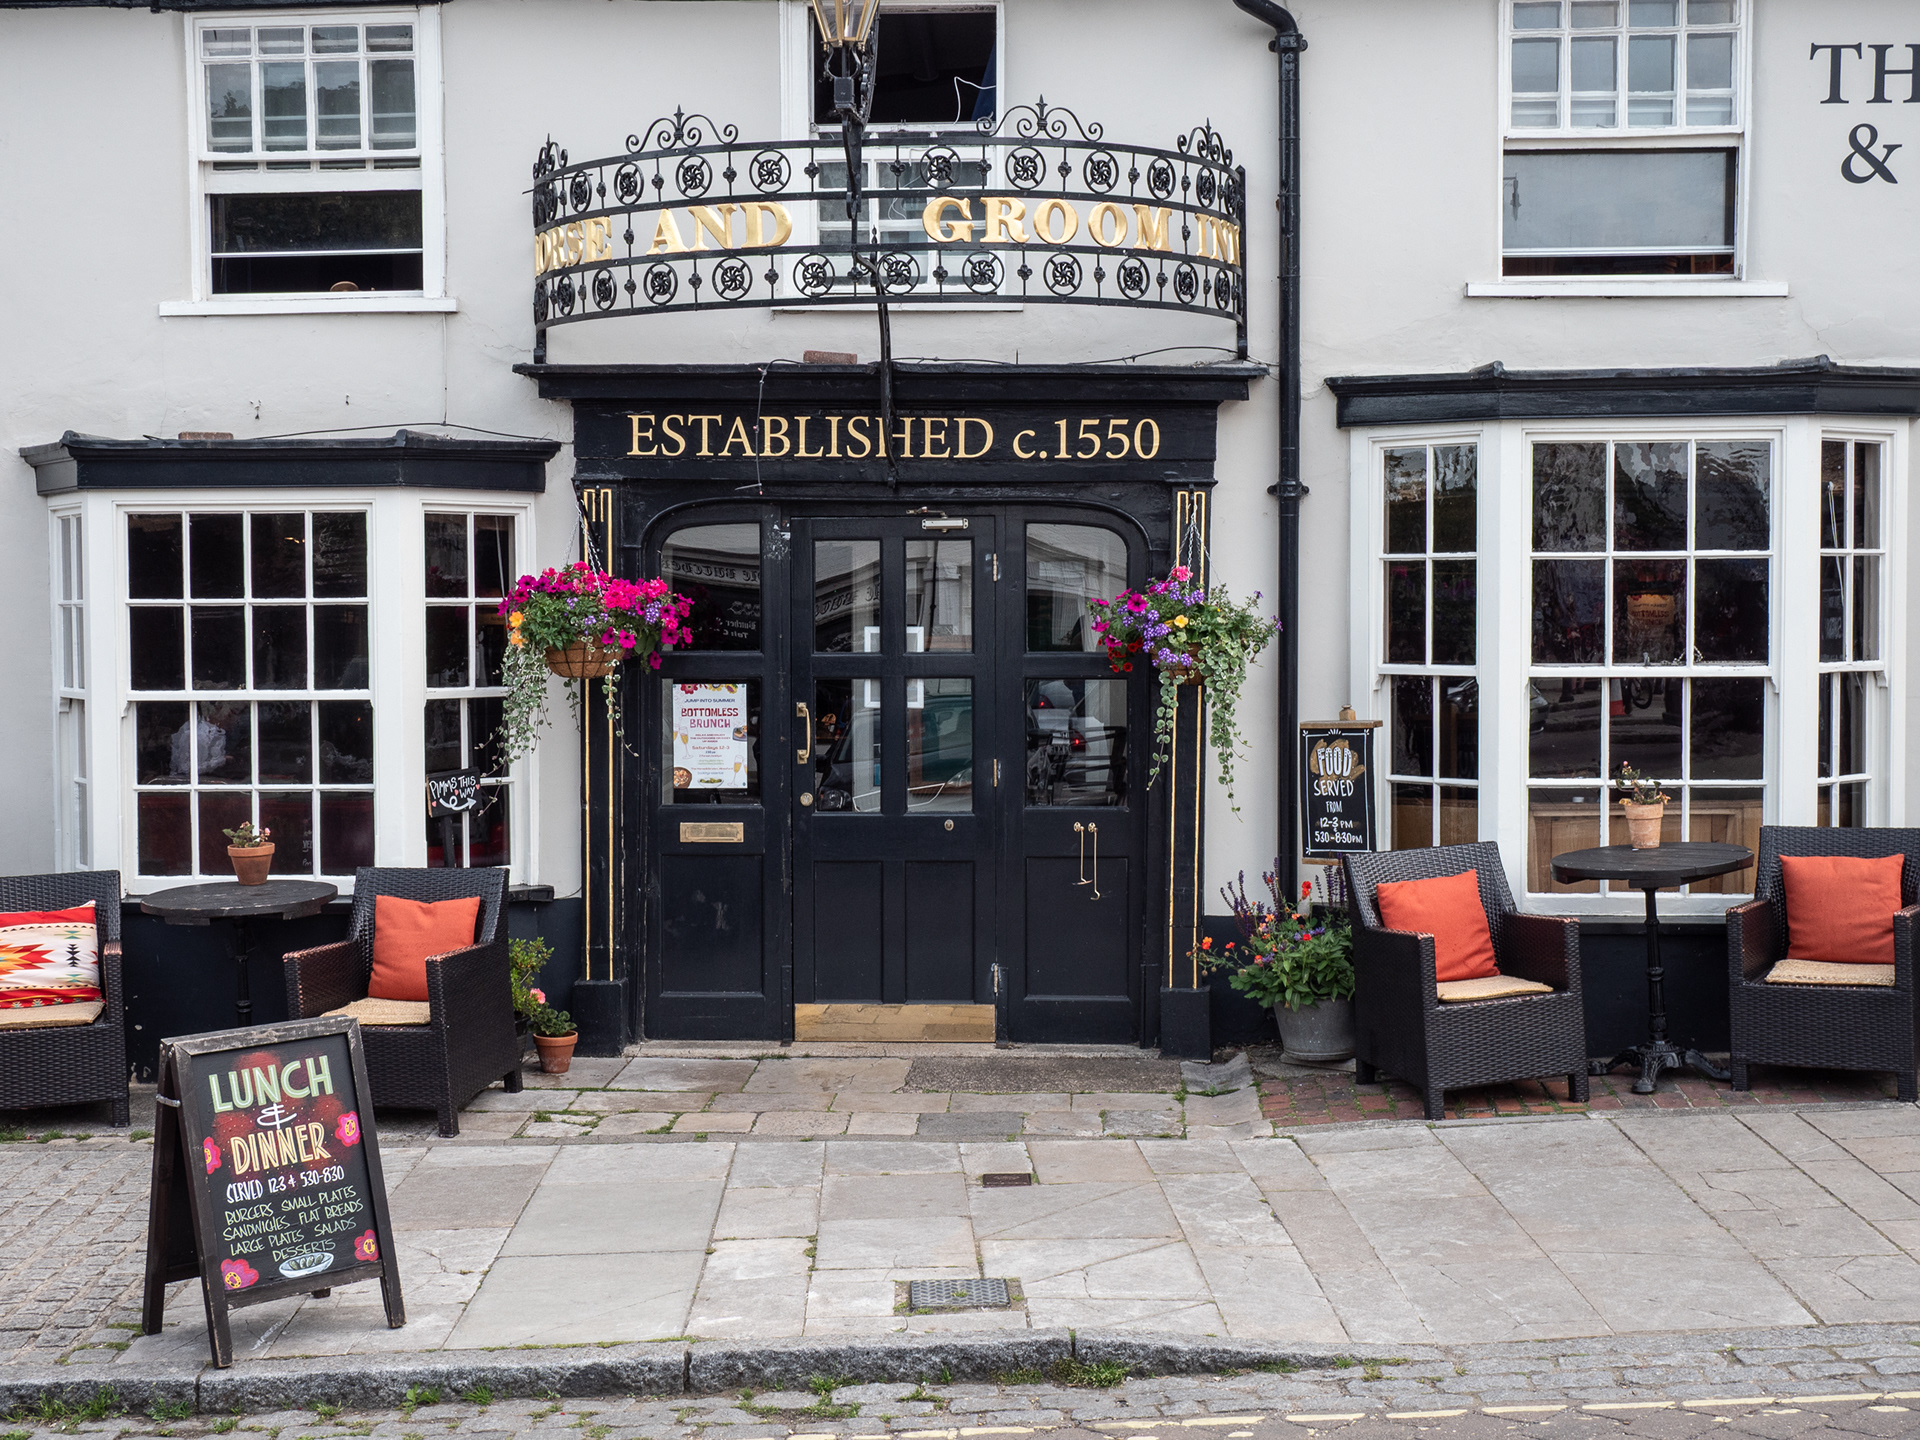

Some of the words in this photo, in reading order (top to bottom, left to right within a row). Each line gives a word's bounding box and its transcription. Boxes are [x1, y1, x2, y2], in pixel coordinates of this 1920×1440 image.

[1840, 123, 1903, 184] &
[535, 216, 612, 278] ORSE
[646, 201, 793, 255] AND
[922, 196, 1173, 252] GROOM
[626, 414, 994, 459] ESTABLISHED
[1012, 417, 1160, 460] c.1550
[681, 707, 739, 717] BOTTOMLESS
[690, 719, 731, 728] BRUNCH
[1316, 747, 1352, 777] FOOD
[458, 775, 476, 788] THIS
[459, 787, 476, 798] WAY
[1313, 779, 1354, 797] SERVED
[1325, 801, 1343, 814] FROM
[1320, 816, 1339, 828] 12-3
[1340, 820, 1353, 829] PM
[208, 1055, 334, 1114] LUNCH
[230, 1122, 332, 1175] DINNER
[226, 1178, 264, 1204] SERVED
[222, 1215, 291, 1241] SANDWICHES
[298, 1206, 321, 1226] FLAT
[324, 1198, 364, 1219] BREADS
[224, 1202, 275, 1226] BURGERS
[281, 1195, 318, 1212] SMALL
[318, 1185, 357, 1205] PLATES
[230, 1238, 266, 1257] LARGE
[268, 1229, 305, 1248] PLATES
[314, 1216, 357, 1238] SALADS
[272, 1238, 336, 1263] DESSERTS
